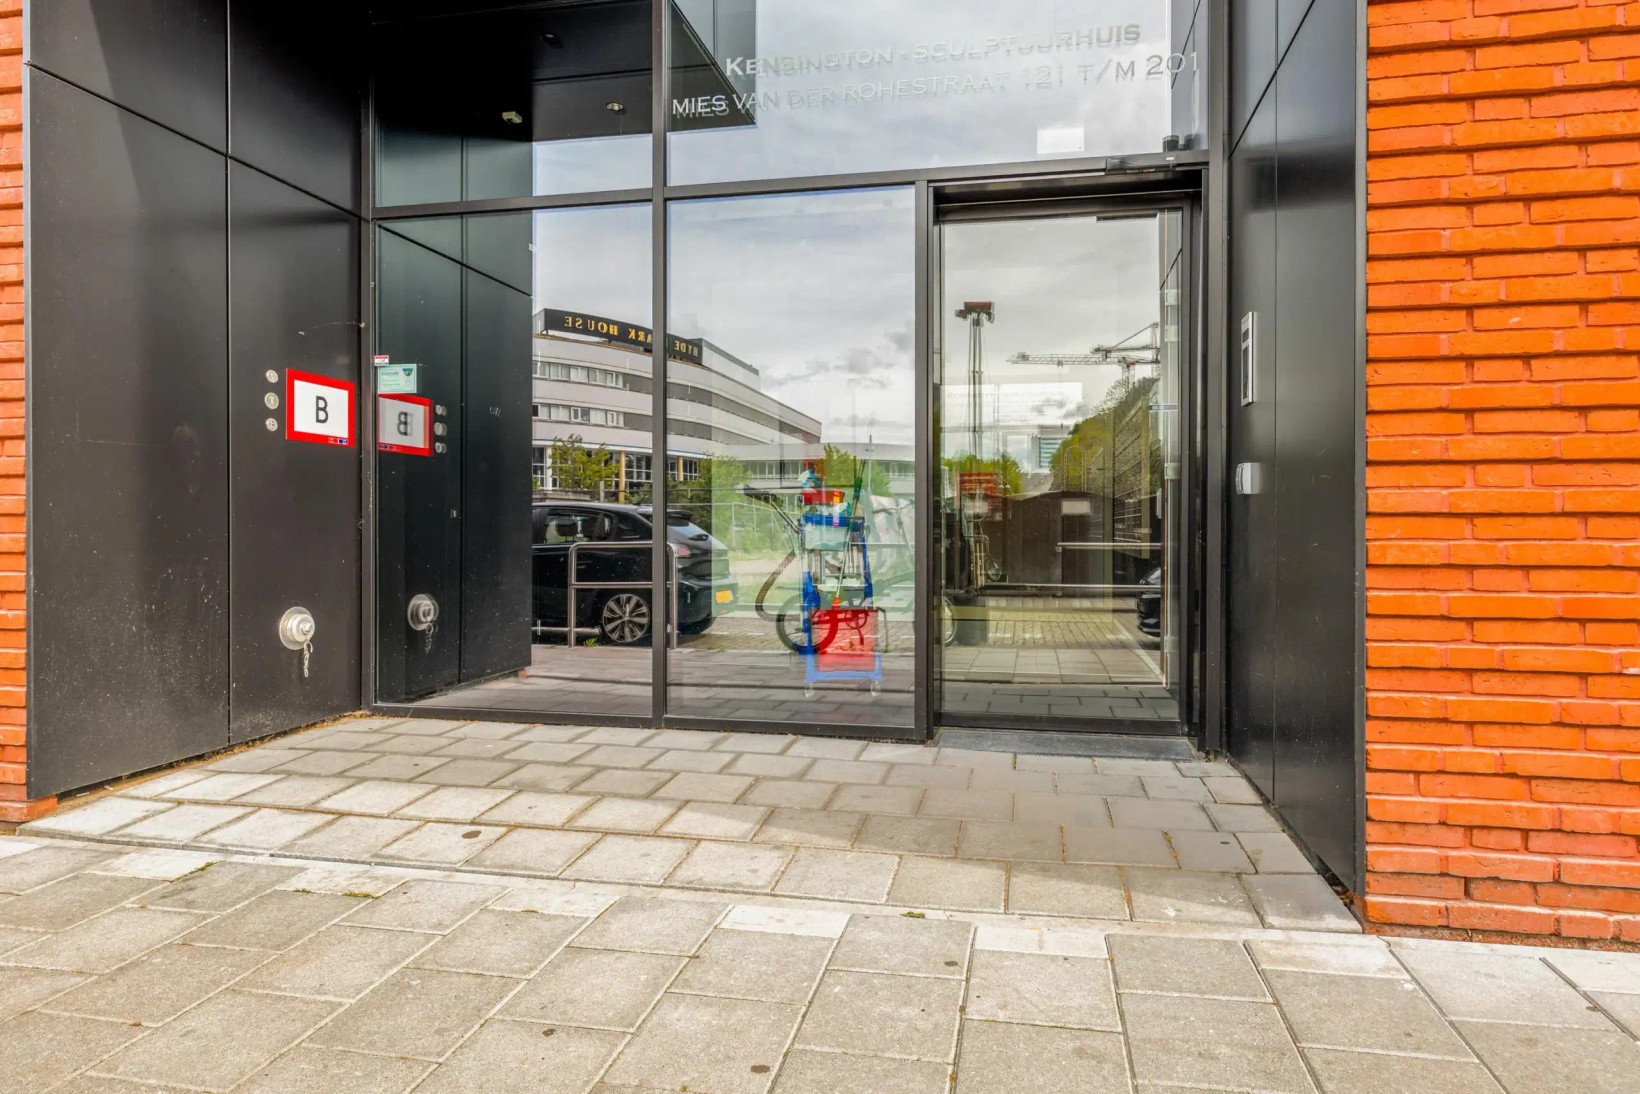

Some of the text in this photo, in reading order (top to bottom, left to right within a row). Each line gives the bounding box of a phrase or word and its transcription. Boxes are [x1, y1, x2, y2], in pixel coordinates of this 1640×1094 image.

[726, 47, 893, 77] KENSINGTON
[672, 95, 727, 115] MIES
[732, 90, 781, 111] VAN
[787, 86, 835, 109] DER
[842, 72, 1010, 100] ROHESTRAAT
[1078, 59, 1136, 84] T/M
[1145, 51, 1199, 80] 201
[315, 395, 329, 424] B
